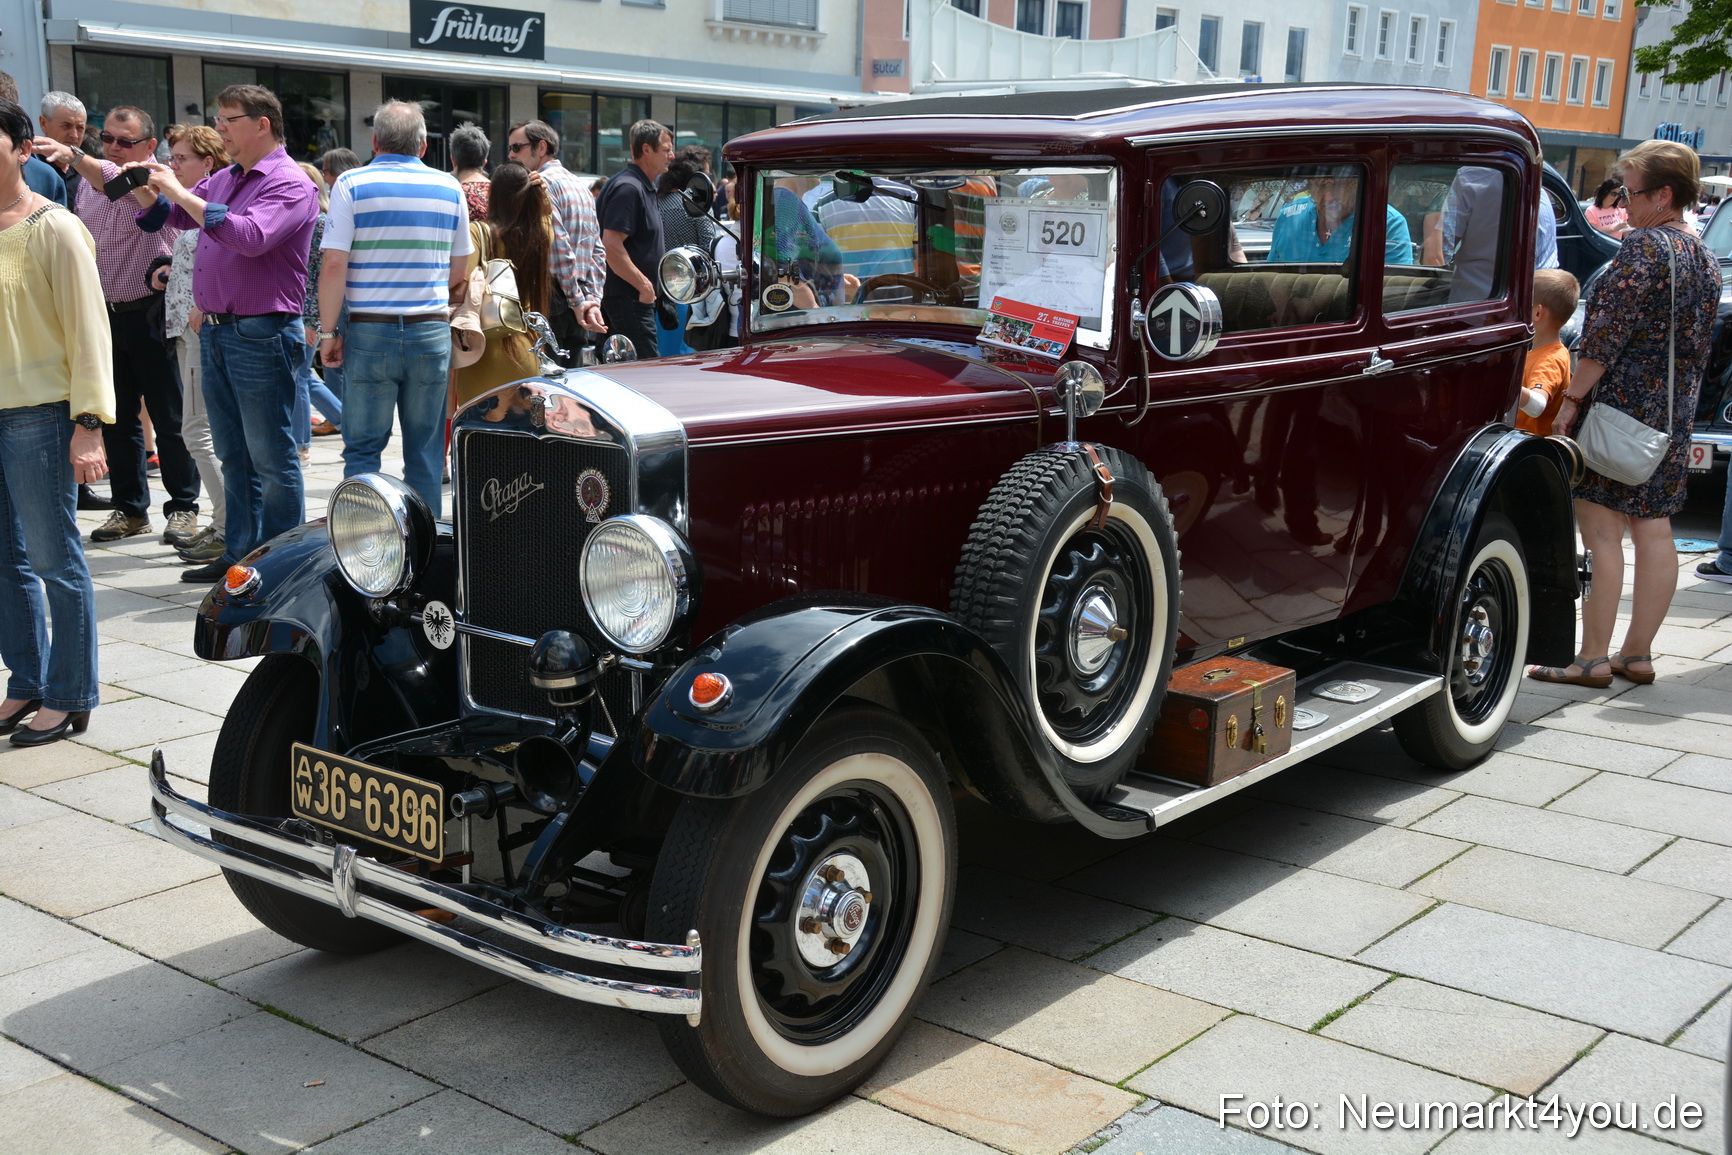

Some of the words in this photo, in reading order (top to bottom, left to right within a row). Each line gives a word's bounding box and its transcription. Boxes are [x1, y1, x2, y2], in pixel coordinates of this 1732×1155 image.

[418, 6, 541, 53] frühauf
[873, 61, 900, 74] sutor
[1041, 220, 1086, 247] 520
[1037, 312, 1050, 323] 27.
[480, 471, 544, 522] Praga
